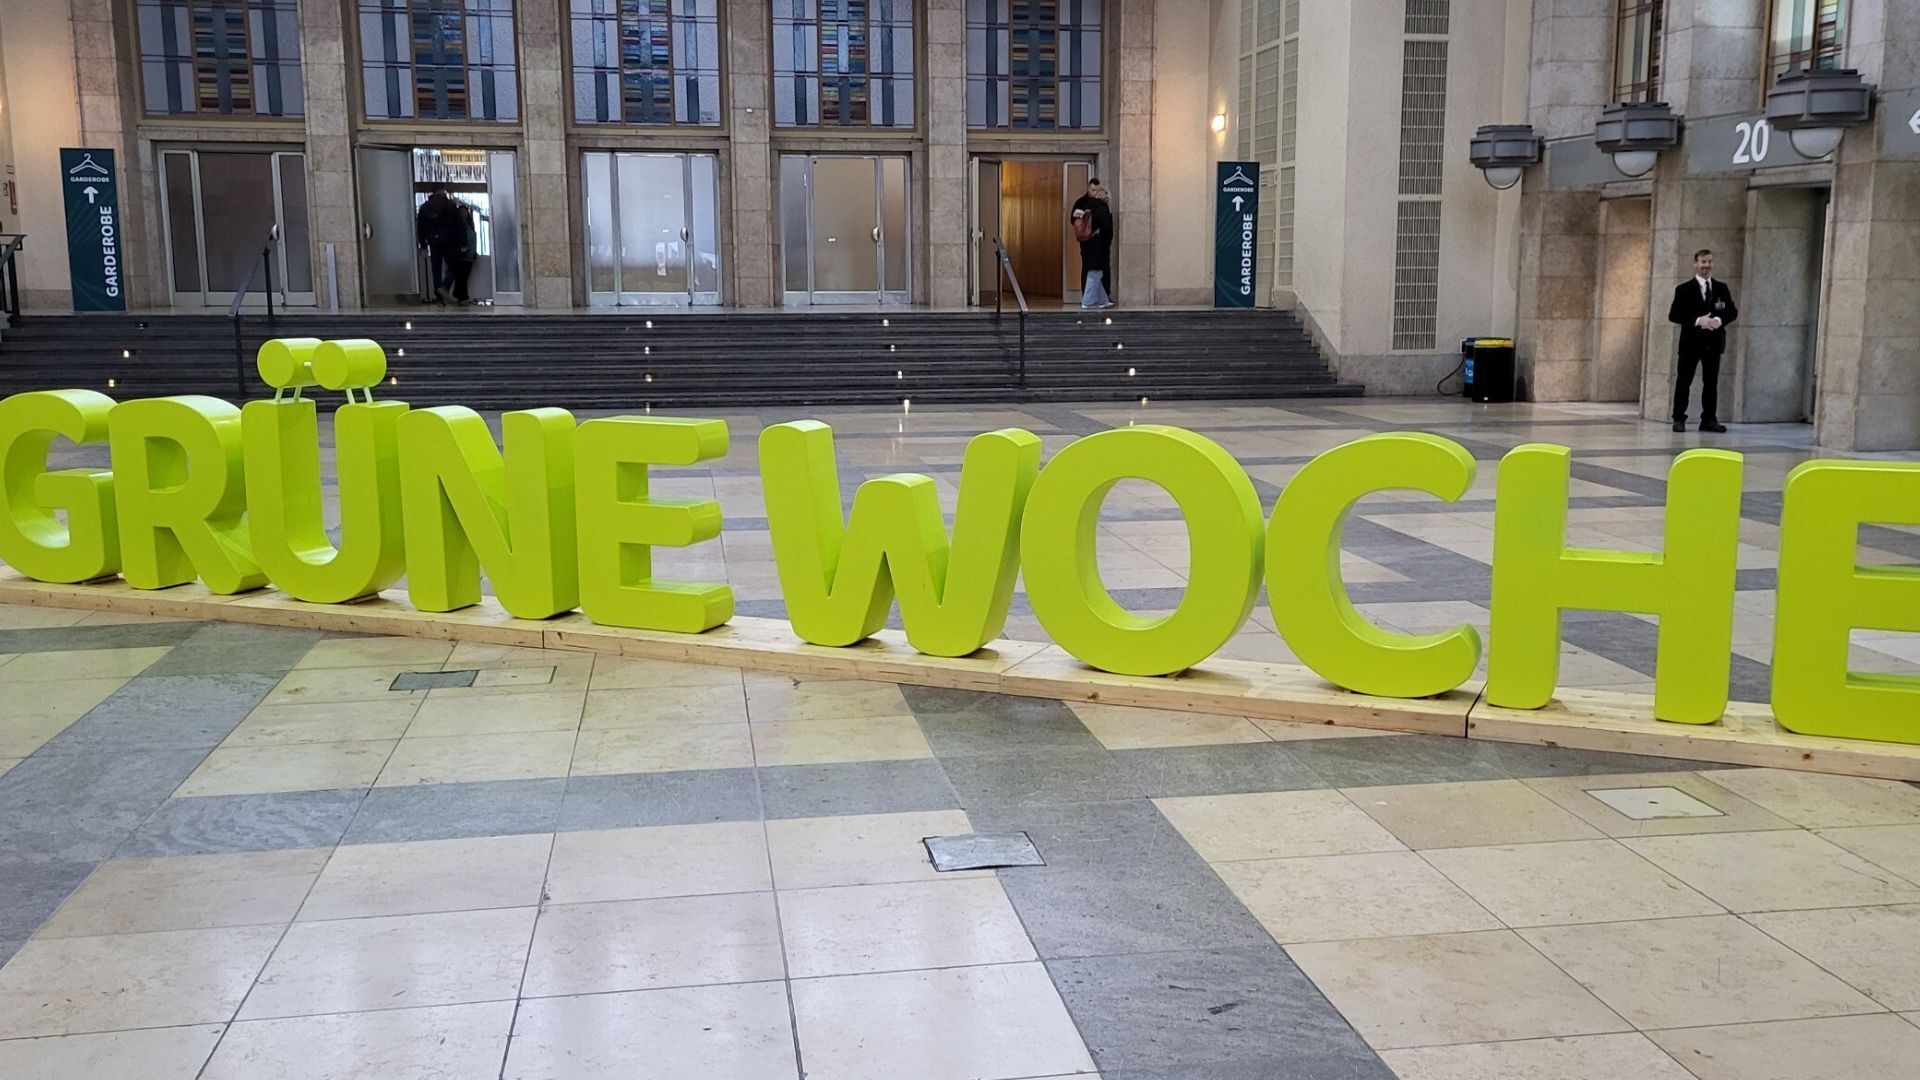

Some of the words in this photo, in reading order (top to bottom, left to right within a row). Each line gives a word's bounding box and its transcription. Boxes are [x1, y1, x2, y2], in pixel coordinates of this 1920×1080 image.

[1732, 119, 1769, 165] 20
[100, 206, 119, 298] GARDEROBE
[1240, 213, 1253, 296] GARDEROBE
[0, 337, 734, 634] GRÜNE
[759, 419, 1920, 744] WOCHE
